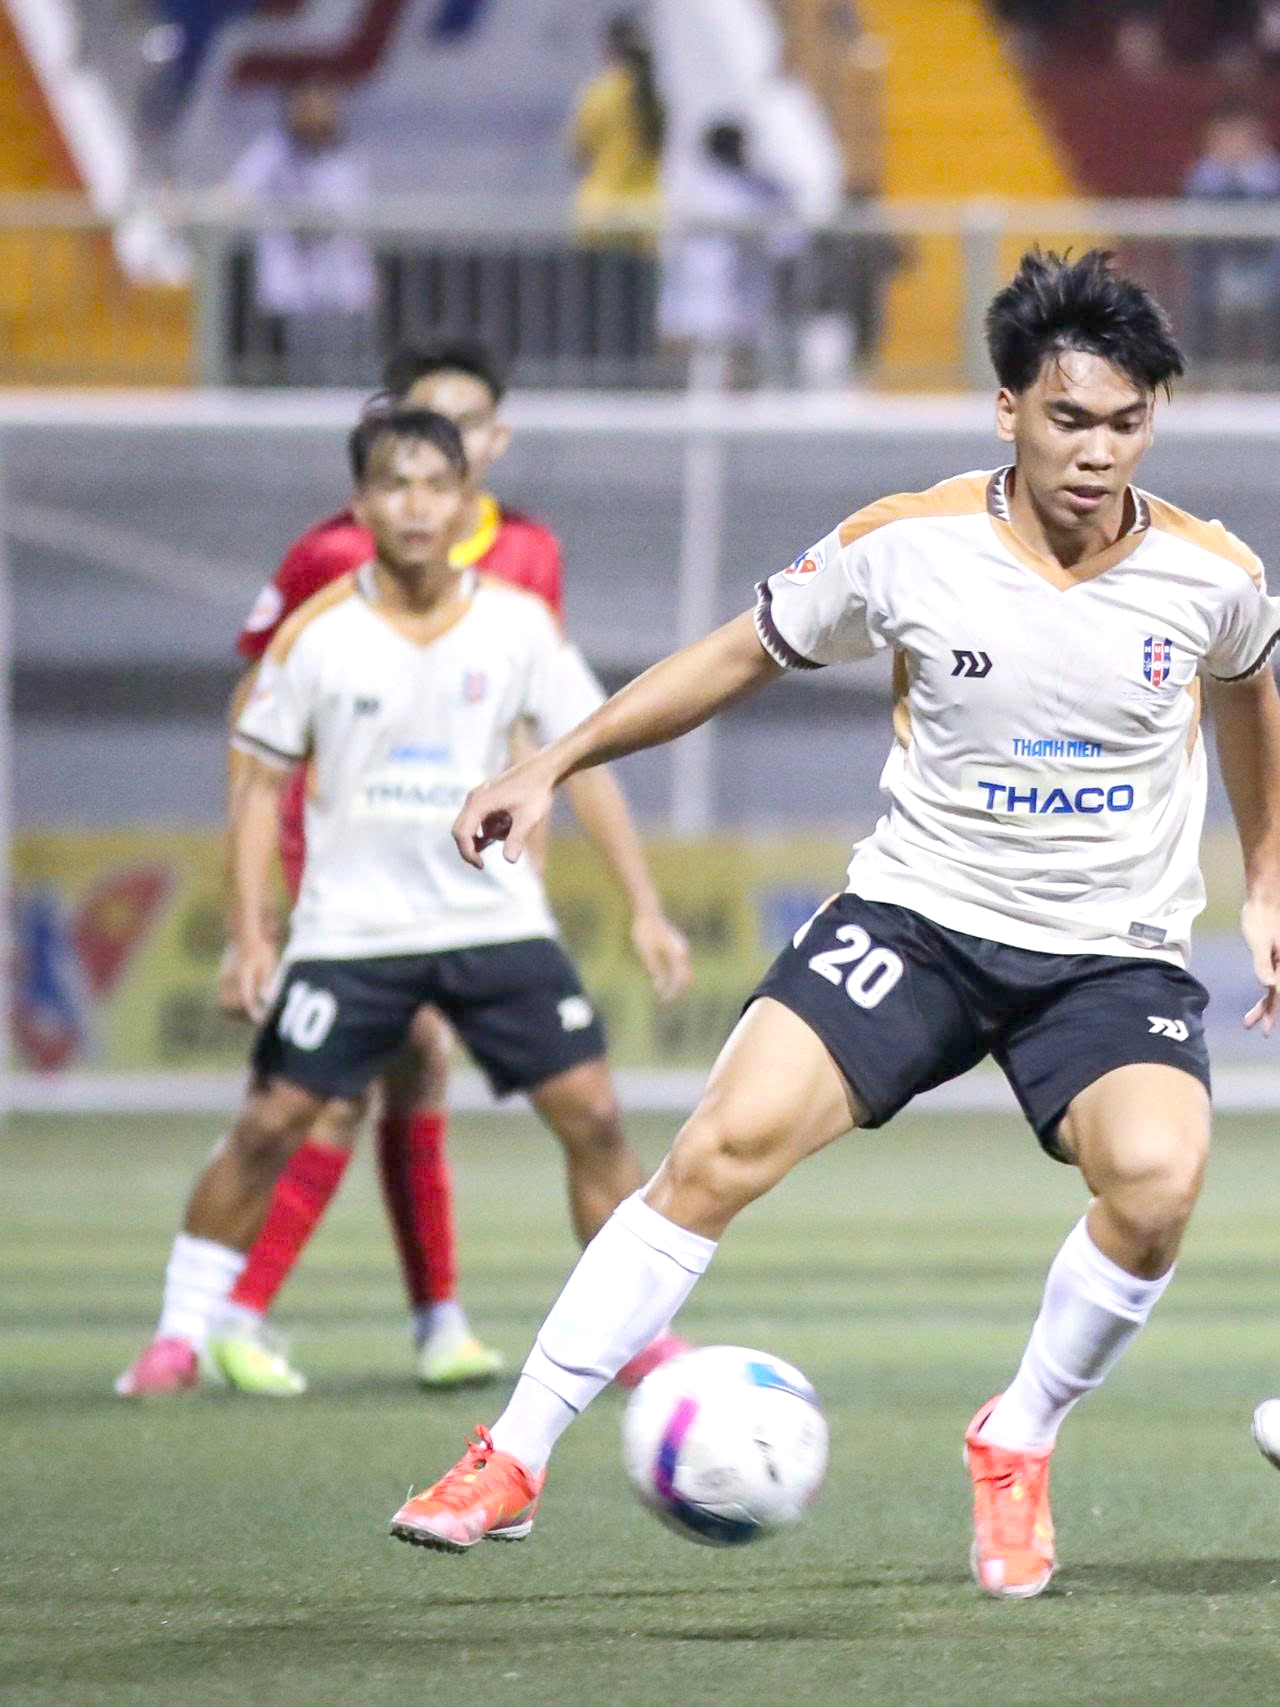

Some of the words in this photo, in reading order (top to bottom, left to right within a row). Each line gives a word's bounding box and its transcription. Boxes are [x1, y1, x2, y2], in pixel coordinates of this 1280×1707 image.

[1012, 738, 1065, 757] THANH
[977, 780, 1134, 814] THACO
[808, 923, 904, 1010] 20
[279, 980, 339, 1052] 10
